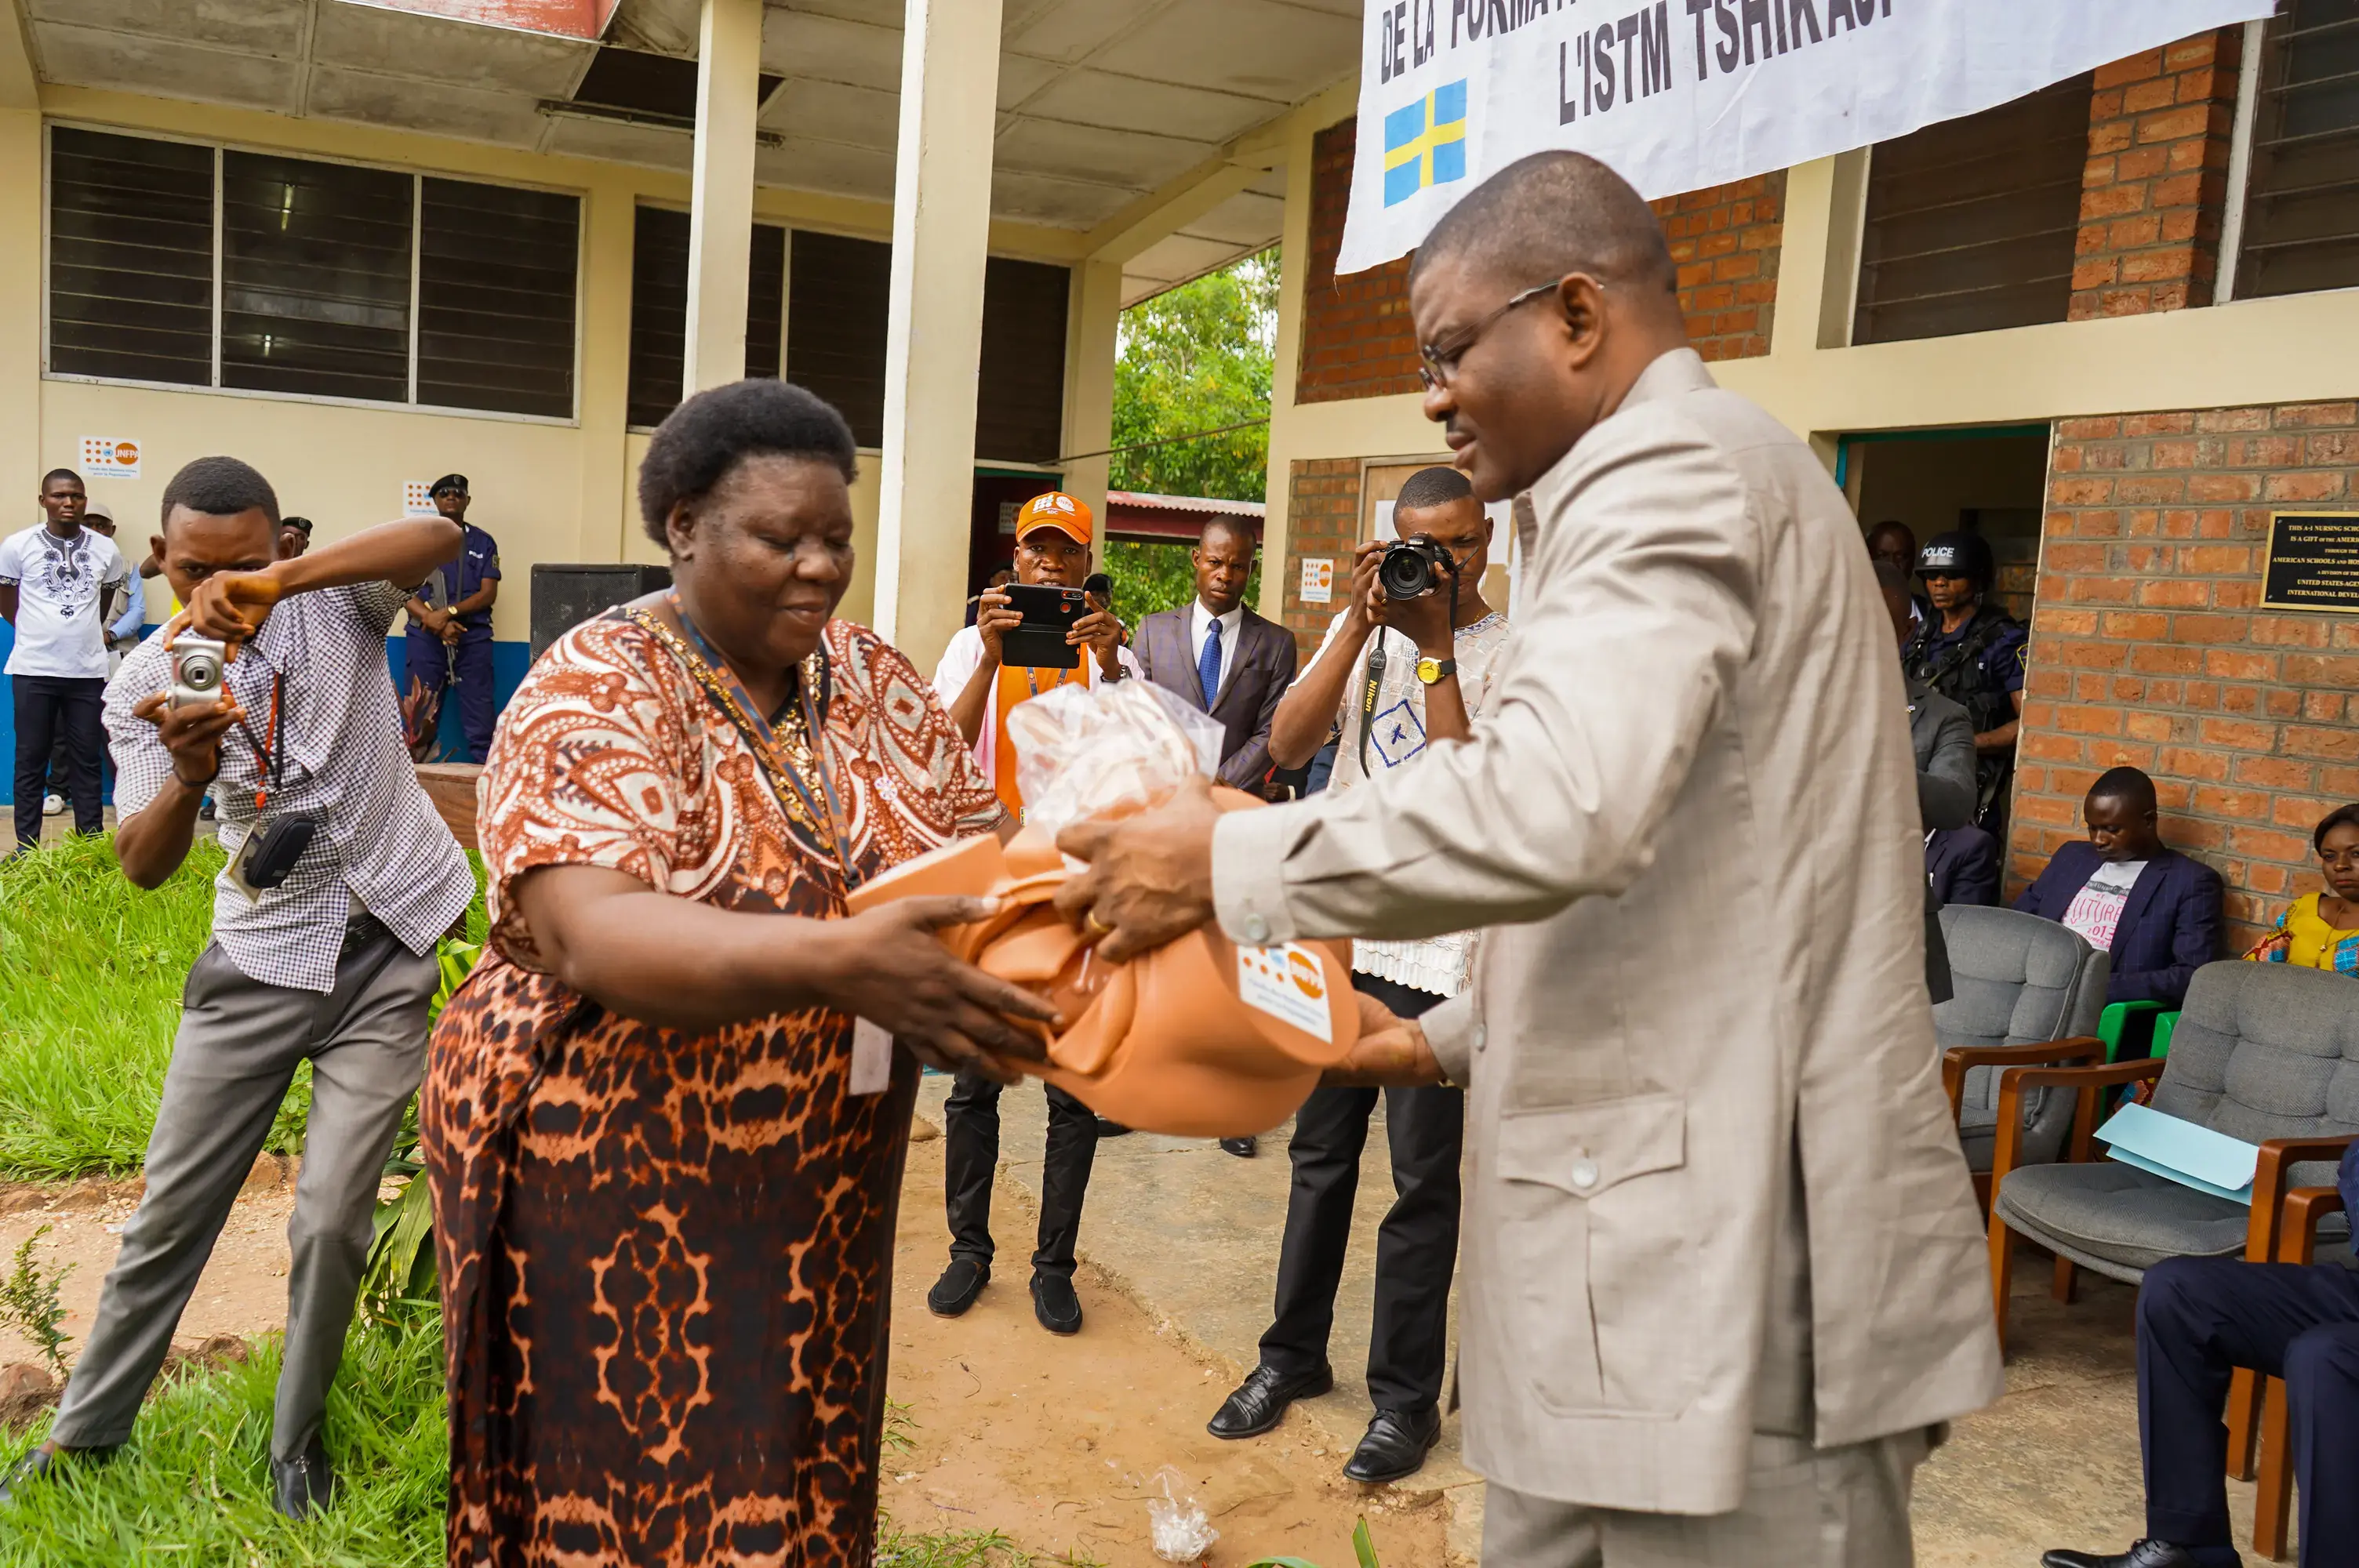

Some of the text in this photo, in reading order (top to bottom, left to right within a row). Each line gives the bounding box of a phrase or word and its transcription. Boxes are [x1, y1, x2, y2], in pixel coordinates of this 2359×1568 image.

[1381, 0, 1406, 85] DE
[1413, 0, 1434, 69] LA
[1559, 0, 1672, 126] L'ISTM
[1921, 546, 1955, 559] POLICE
[1365, 679, 1378, 713] Nikon
